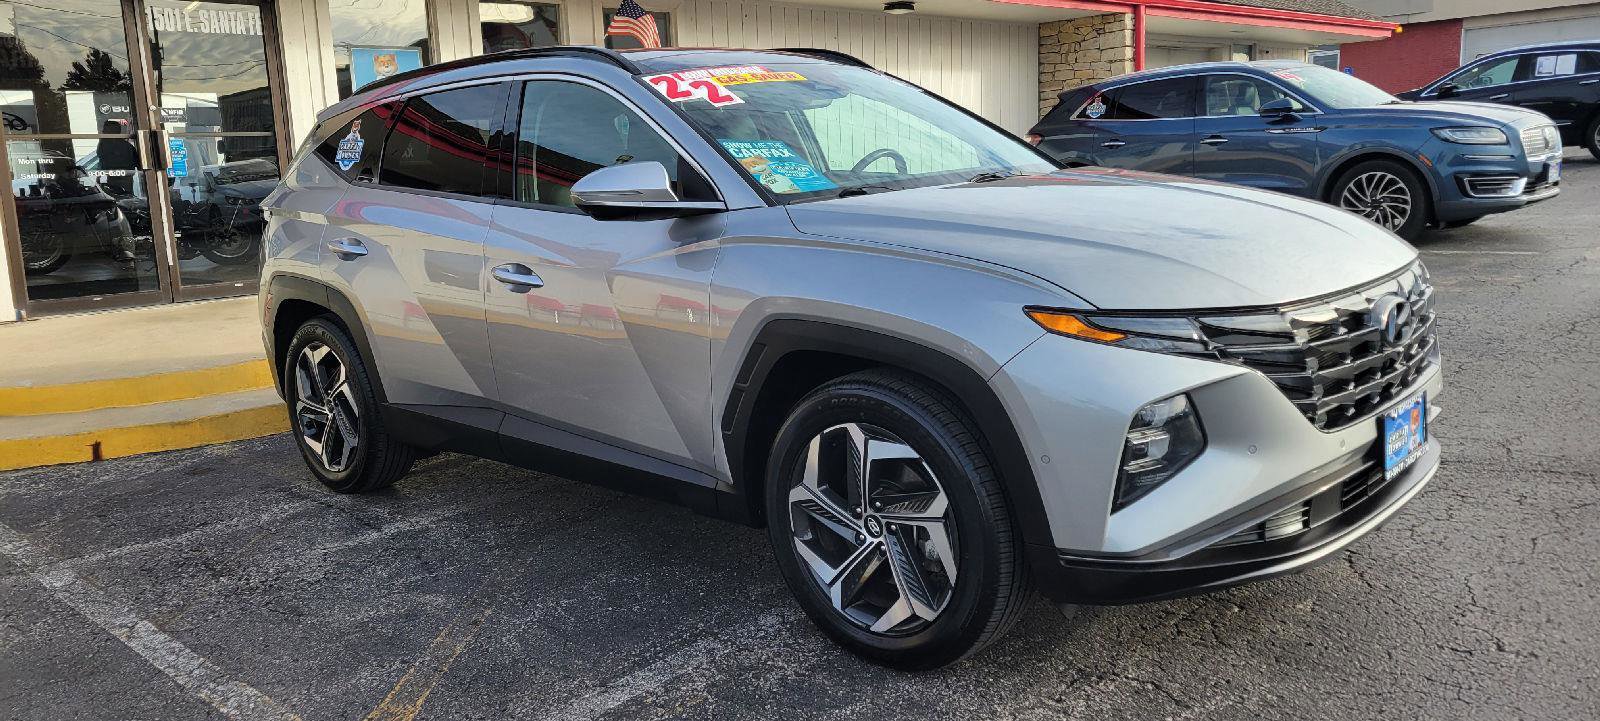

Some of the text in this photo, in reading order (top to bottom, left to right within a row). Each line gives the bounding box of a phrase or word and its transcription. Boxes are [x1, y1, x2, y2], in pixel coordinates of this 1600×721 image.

[145, 6, 182, 31] 1501
[199, 10, 247, 35] SANTA
[722, 141, 752, 149] SHOW
[728, 148, 796, 158] CARFAX
